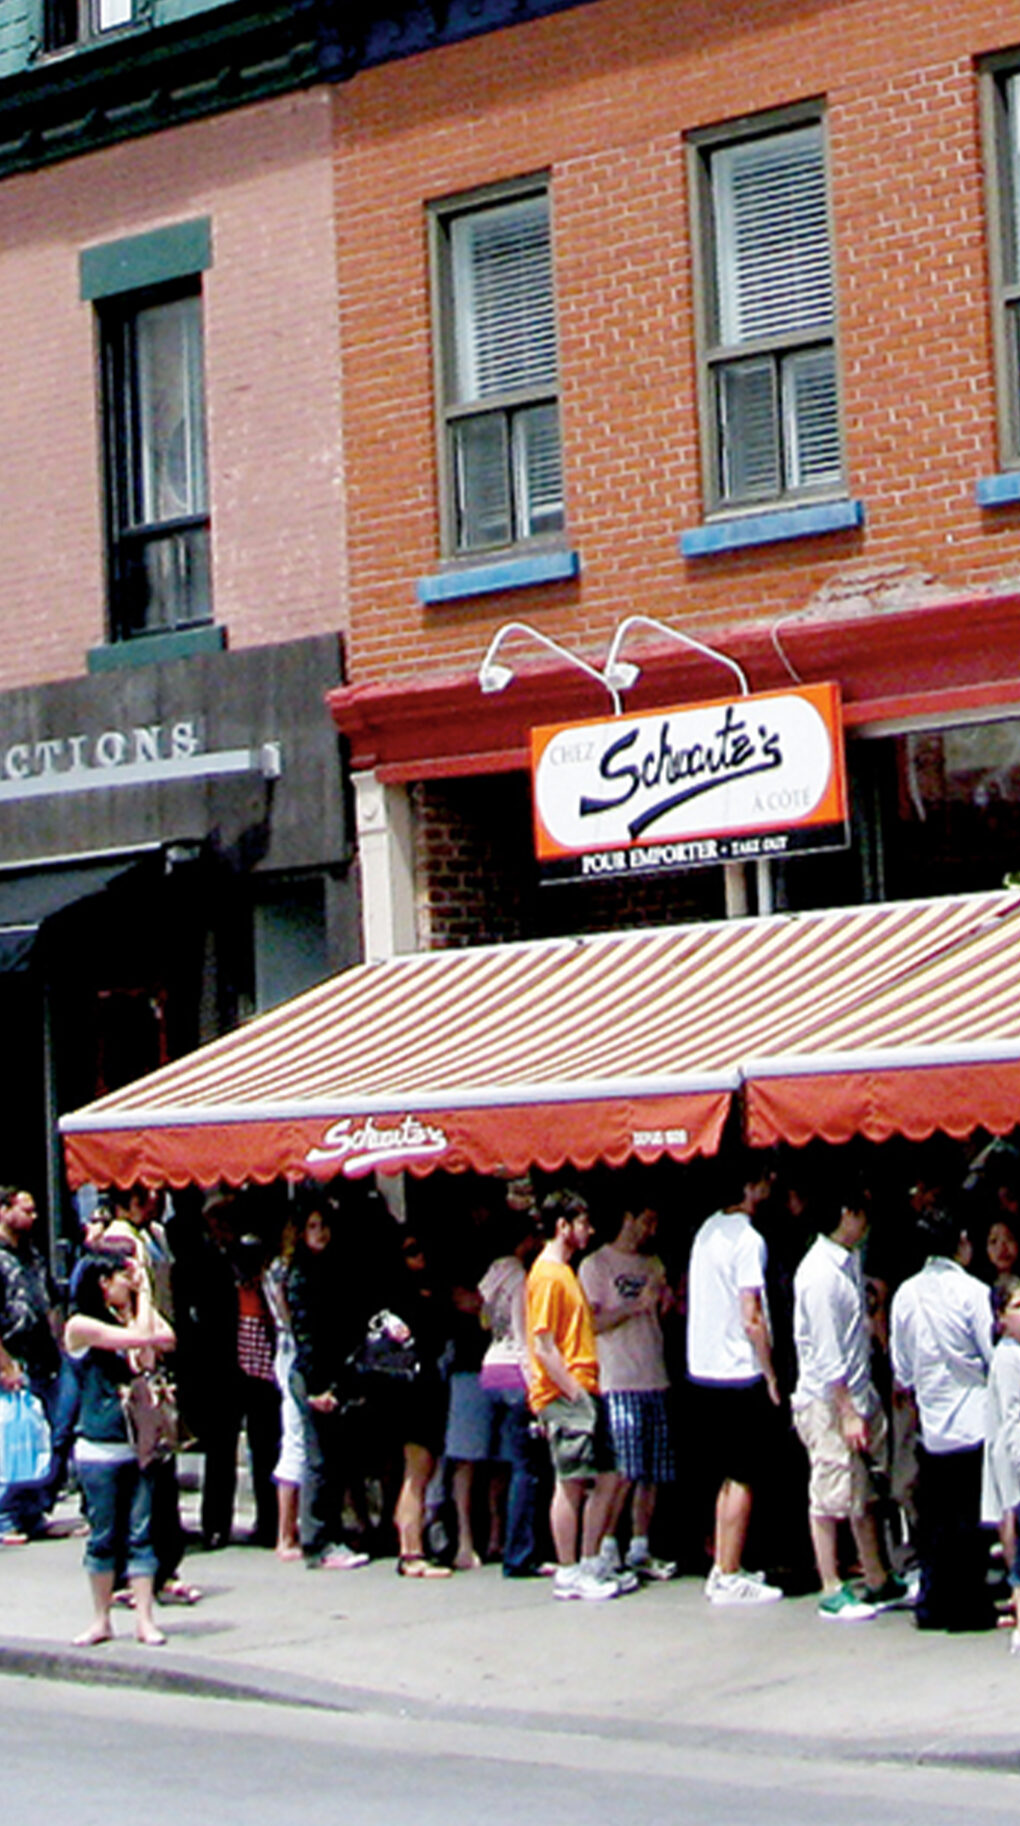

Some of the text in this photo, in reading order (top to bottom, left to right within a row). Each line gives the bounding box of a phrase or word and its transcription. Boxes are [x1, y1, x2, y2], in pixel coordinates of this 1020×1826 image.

[5, 721, 199, 780] CTIONS
[549, 741, 596, 767] CHEZ
[582, 851, 626, 874] POUR
[630, 839, 718, 869] EMPORTER
[761, 836, 789, 851] OUT
